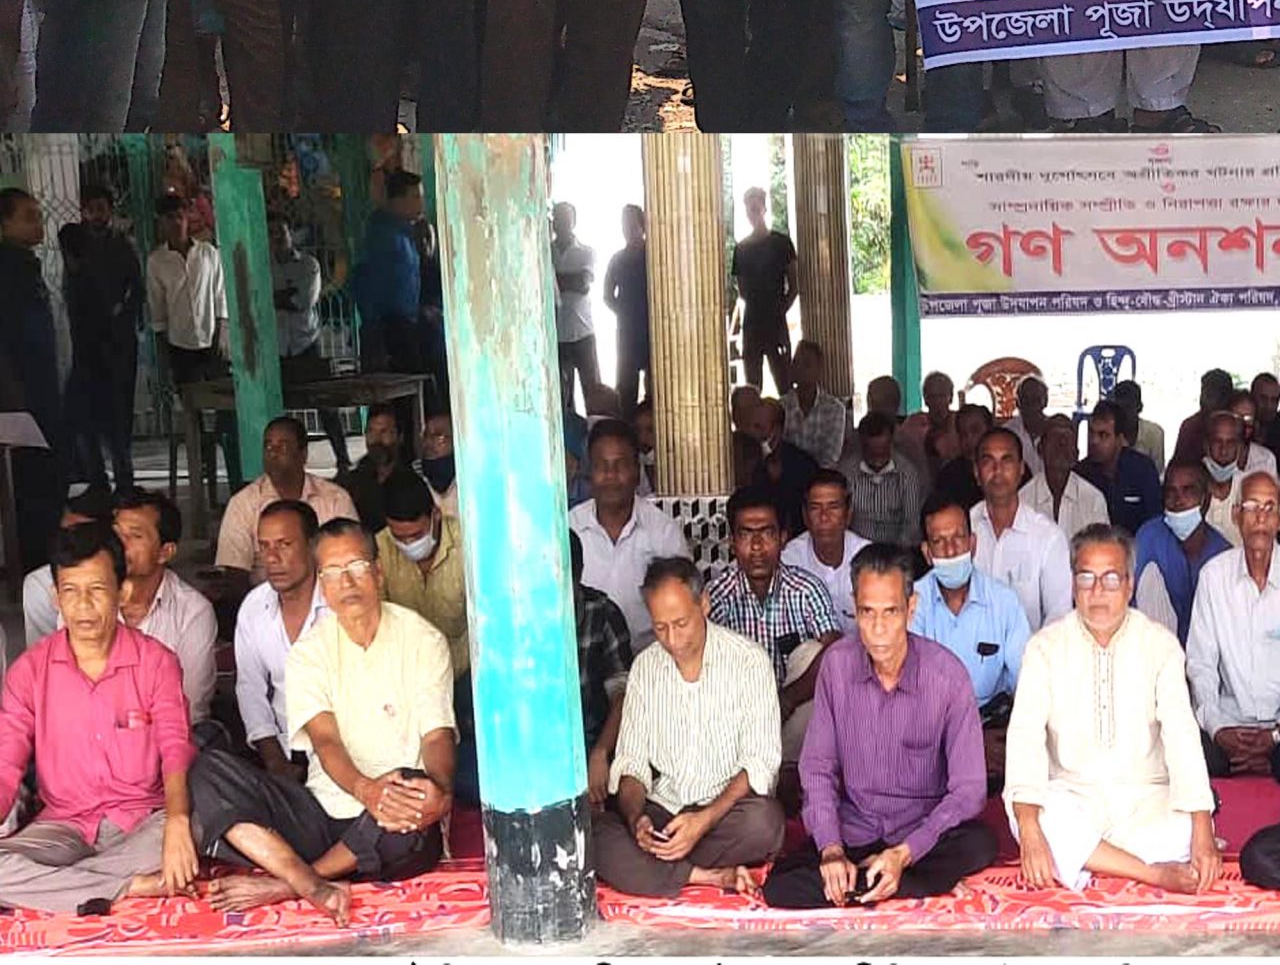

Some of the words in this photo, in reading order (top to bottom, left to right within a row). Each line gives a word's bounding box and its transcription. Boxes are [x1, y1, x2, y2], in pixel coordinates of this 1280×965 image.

[932, 4, 1074, 45] উপজেলা
[1088, 0, 1153, 40] পূজা
[965, 221, 1075, 278] গণ
